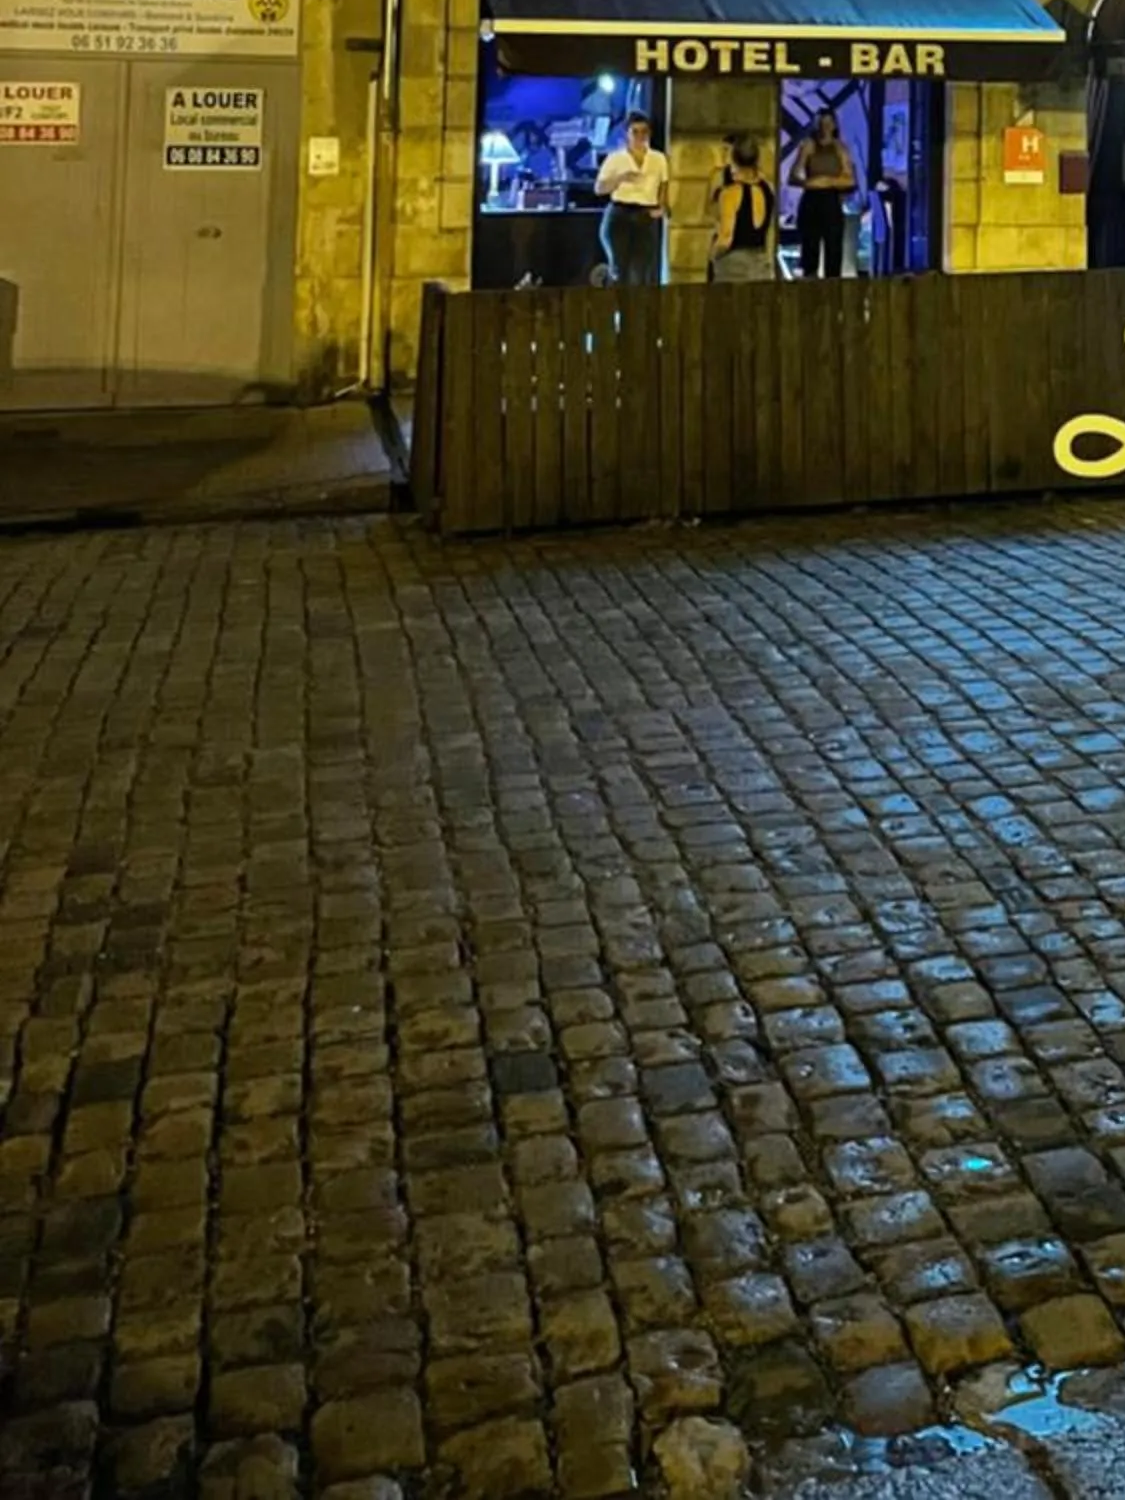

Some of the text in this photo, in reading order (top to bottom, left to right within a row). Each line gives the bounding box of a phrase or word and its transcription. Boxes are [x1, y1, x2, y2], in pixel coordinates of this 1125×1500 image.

[634, 38, 800, 73] HOTEL
[849, 42, 946, 76] BAR
[4, 86, 73, 100] LOUER
[172, 92, 257, 109] A LOUER
[1021, 134, 1039, 154] H
